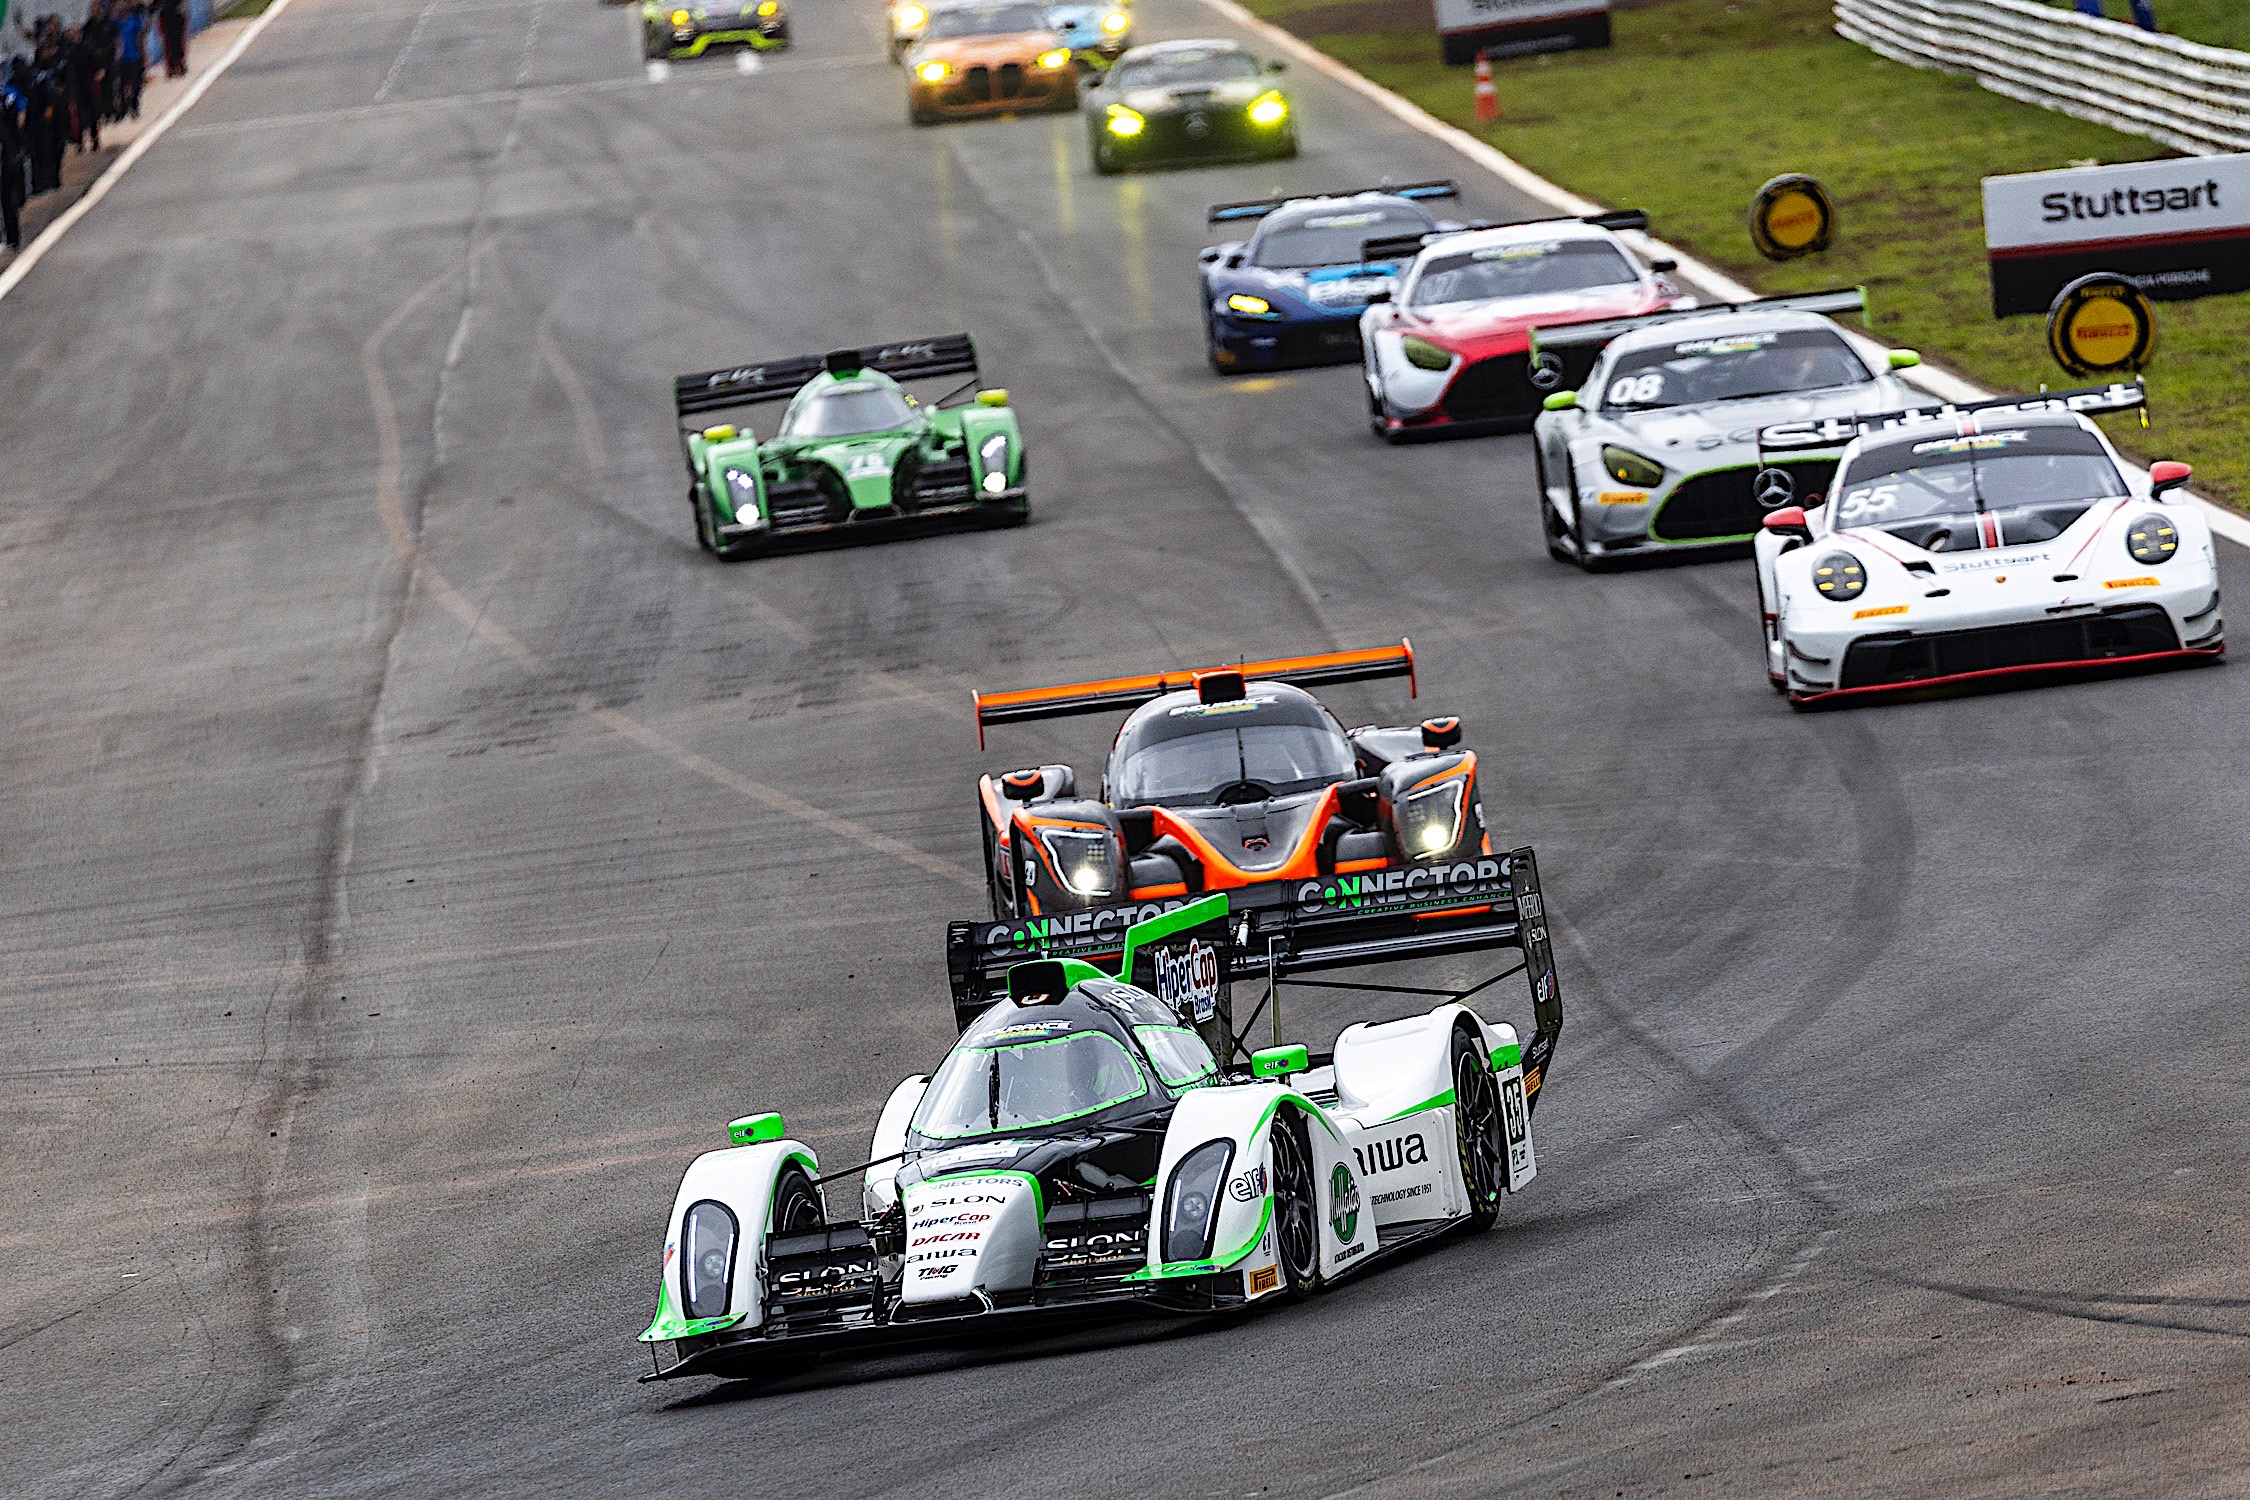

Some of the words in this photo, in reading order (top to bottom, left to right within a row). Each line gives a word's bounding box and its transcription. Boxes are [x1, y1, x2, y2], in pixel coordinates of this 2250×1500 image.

[2042, 180, 2219, 222] Stuttgart
[1608, 374, 1664, 405] 08
[1760, 384, 2144, 446] Stttrt
[1839, 484, 1898, 520] 55
[1942, 552, 2051, 574] Stuttgart
[987, 897, 1207, 957] CONNECTO
[1155, 940, 1218, 1010] HiperCap
[1506, 1082, 1523, 1138] 35
[1229, 1167, 1261, 1203] elf
[1371, 1187, 1407, 1206] TECHNOLOGY
[1406, 1184, 1421, 1198] SINCE
[930, 1194, 1006, 1208] SLON
[911, 1213, 991, 1230] HiperCap
[911, 1232, 981, 1247] DACAR
[1046, 1231, 1141, 1262] SLON
[906, 1248, 978, 1264] aiwa
[918, 1264, 959, 1278] TMG
[780, 1261, 875, 1295] SLON
[1253, 1266, 1277, 1292] PIRELLI
